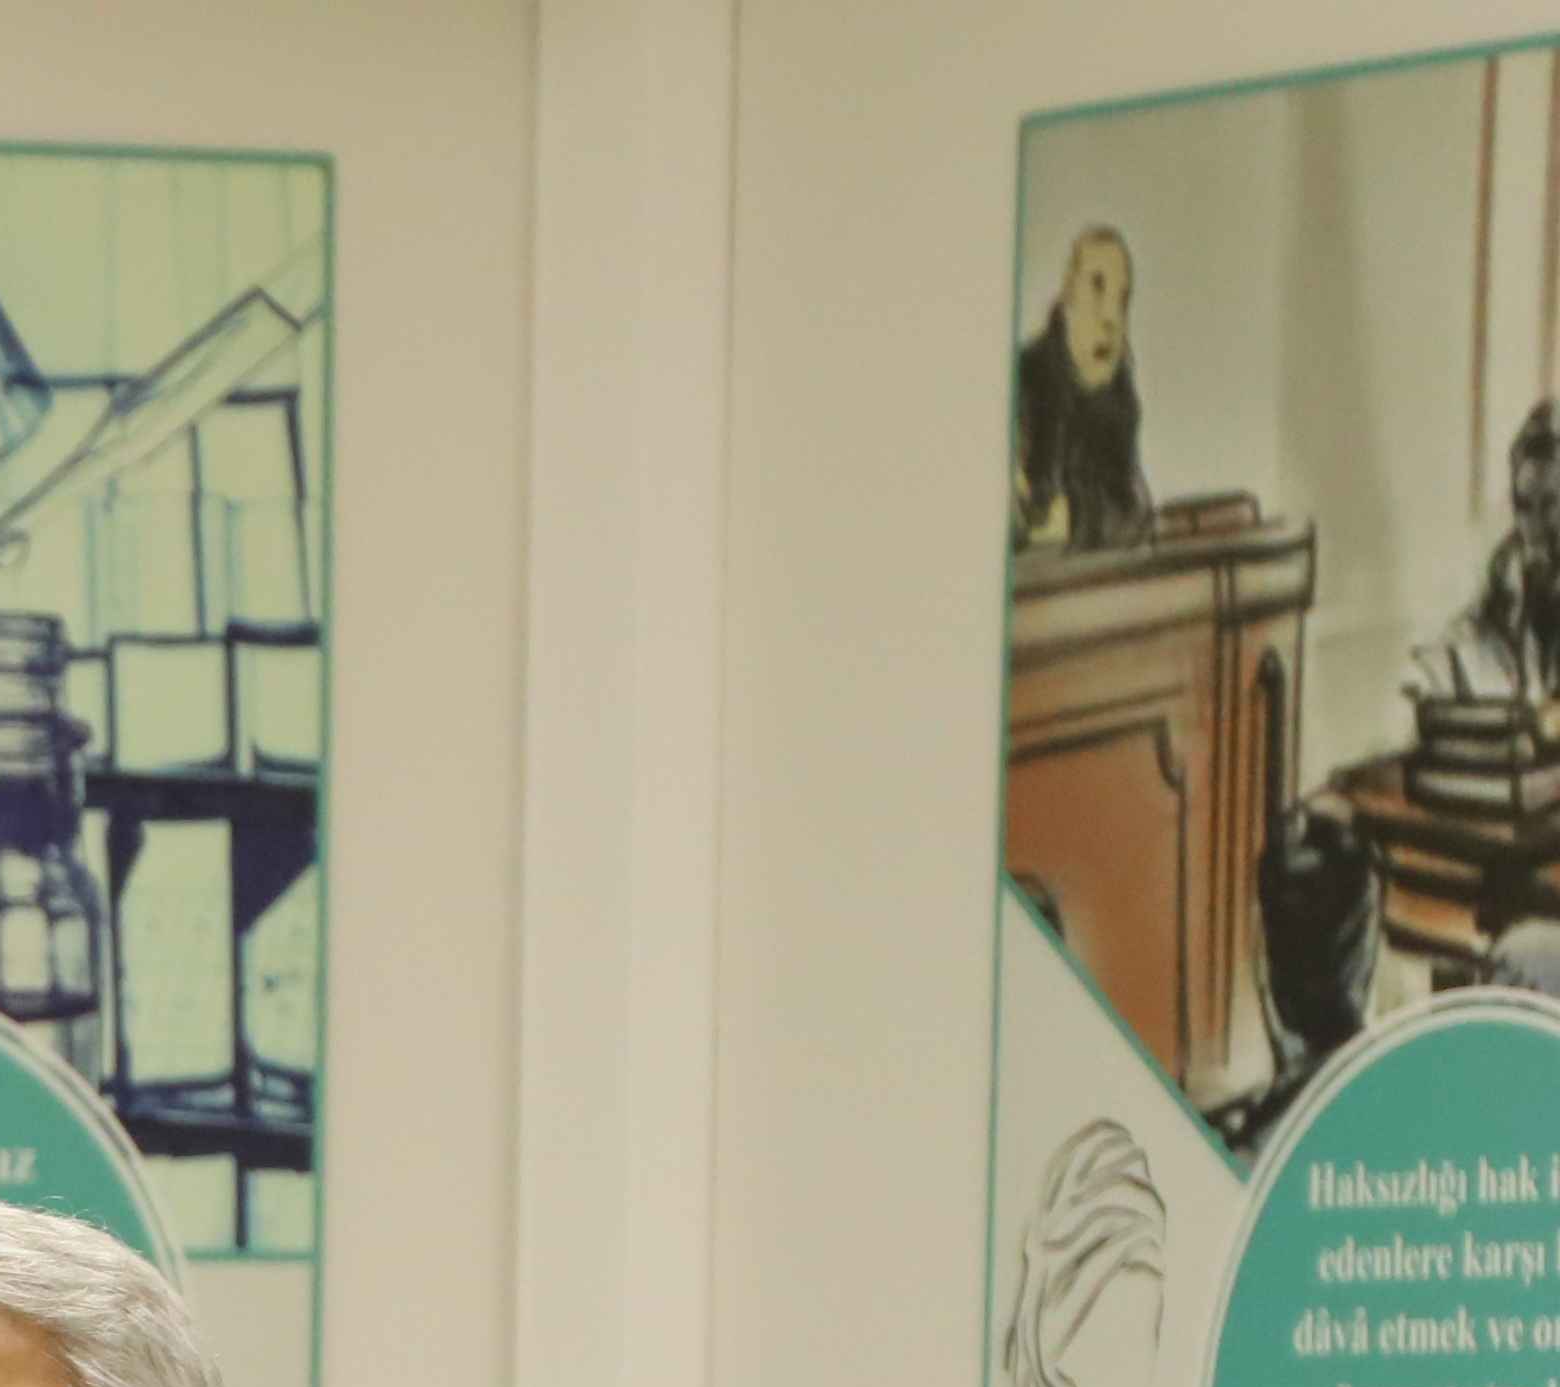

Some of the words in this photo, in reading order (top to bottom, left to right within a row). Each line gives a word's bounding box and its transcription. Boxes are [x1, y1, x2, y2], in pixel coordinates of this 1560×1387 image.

[1308, 1160, 1469, 1217] Haksızlığı
[1478, 1155, 1540, 1204] hak
[1316, 1235, 1454, 1284] edenlere
[1462, 1230, 1546, 1289] karşı
[1378, 1304, 1478, 1355] etmek
[1487, 1317, 1524, 1353] ve
